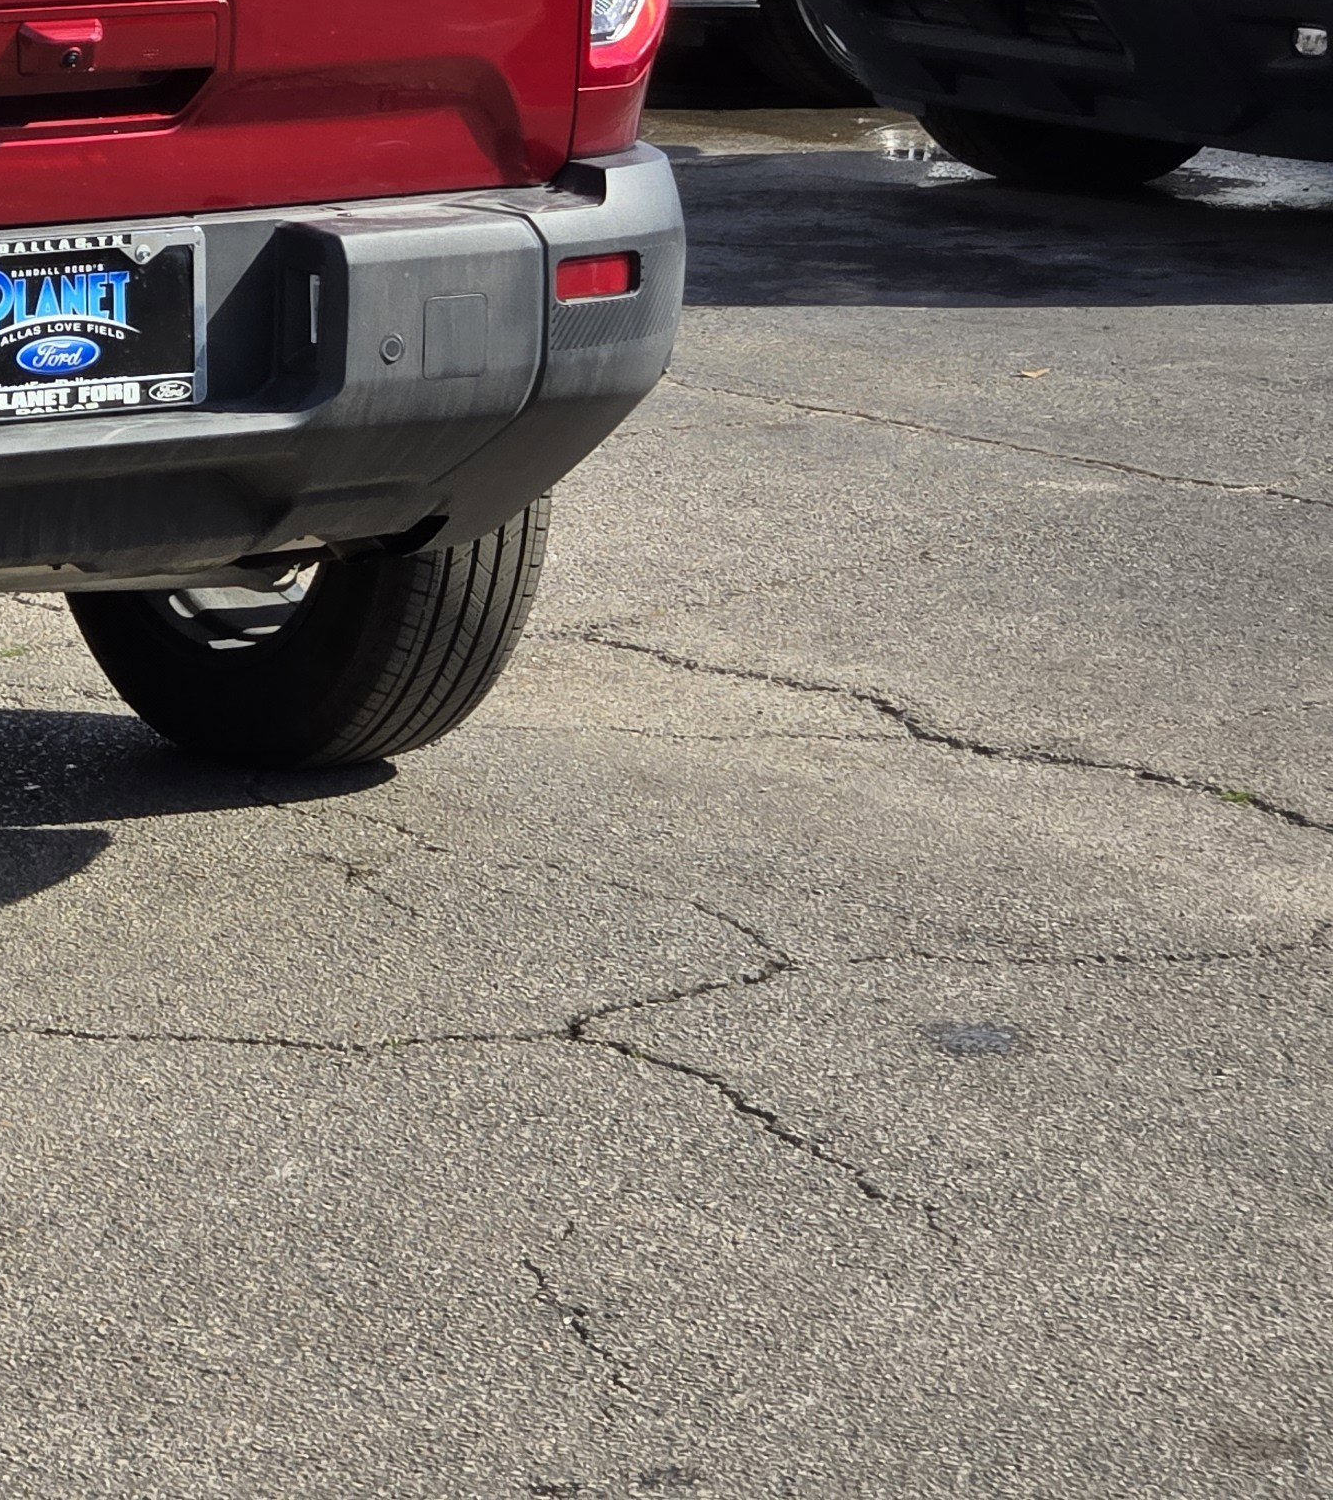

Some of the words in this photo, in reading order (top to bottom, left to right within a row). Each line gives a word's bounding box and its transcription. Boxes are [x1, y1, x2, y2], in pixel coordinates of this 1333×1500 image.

[97, 235, 124, 247] TX
[11, 266, 60, 278] RANDALL
[47, 322, 82, 333] LOVE
[87, 323, 126, 340] FIELD
[32, 341, 83, 368] Ford
[78, 382, 140, 404] FORD
